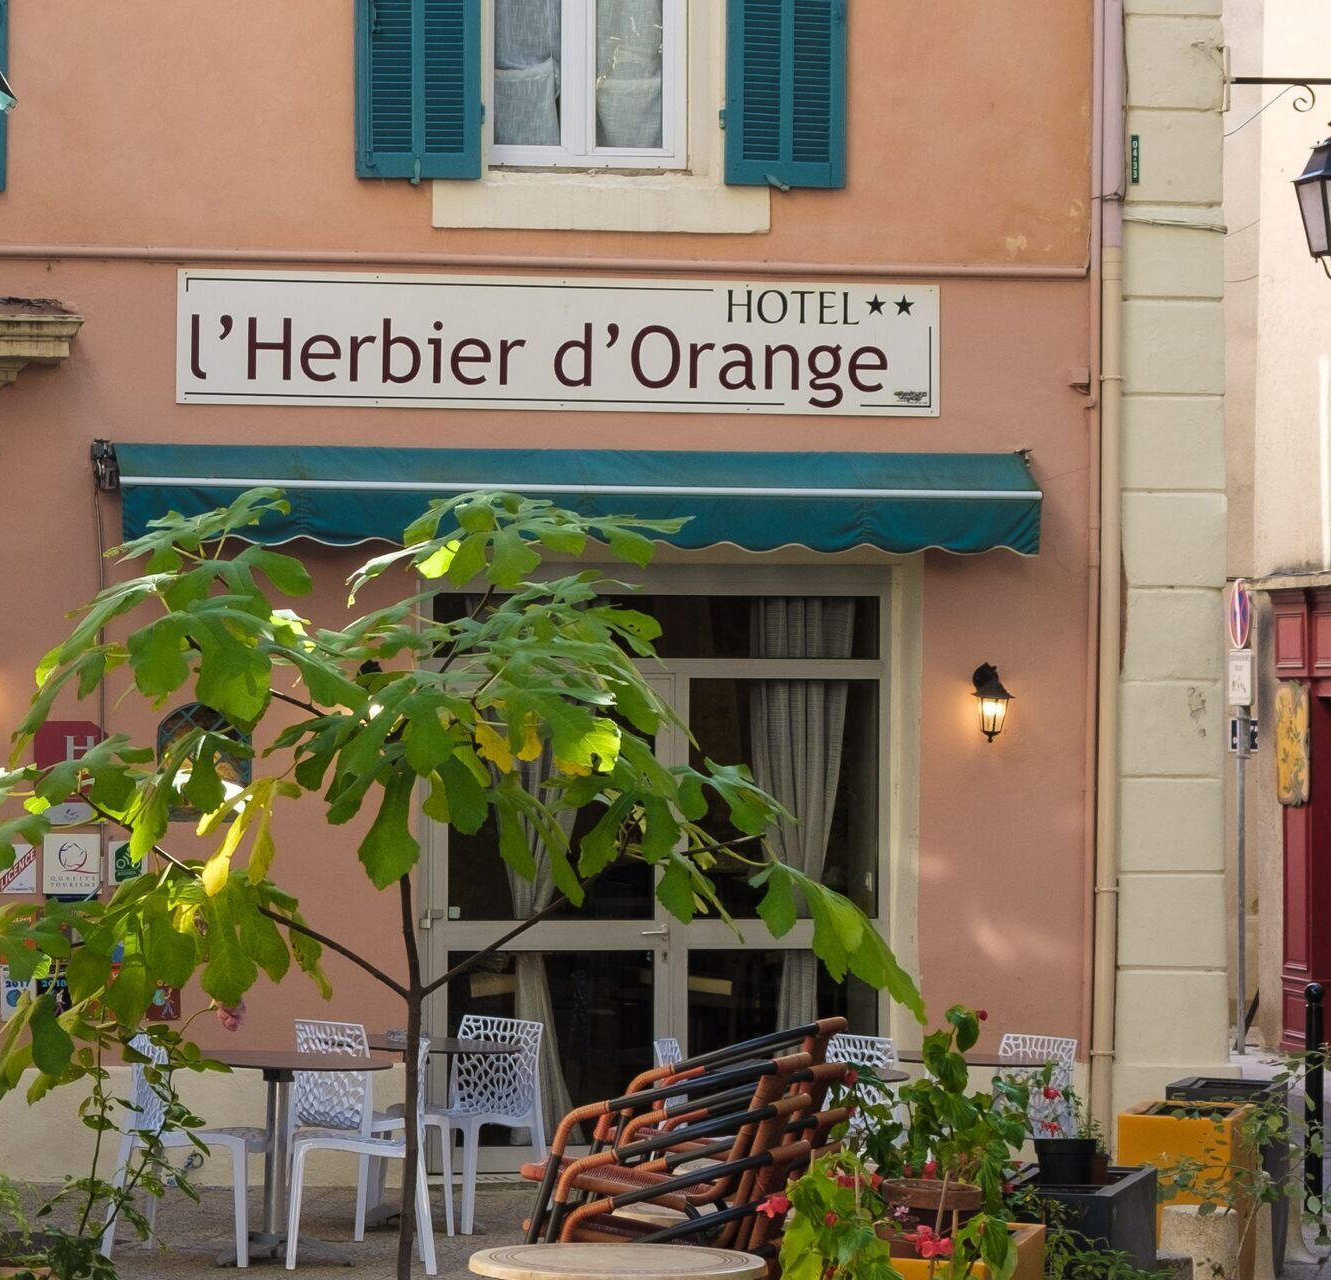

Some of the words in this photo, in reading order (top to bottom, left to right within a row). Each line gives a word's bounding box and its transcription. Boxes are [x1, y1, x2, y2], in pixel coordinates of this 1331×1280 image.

[725, 288, 860, 326] HOTEL
[189, 314, 527, 387] l'Herbier
[553, 321, 888, 409] d'Orange
[0, 847, 36, 890] LICENCE
